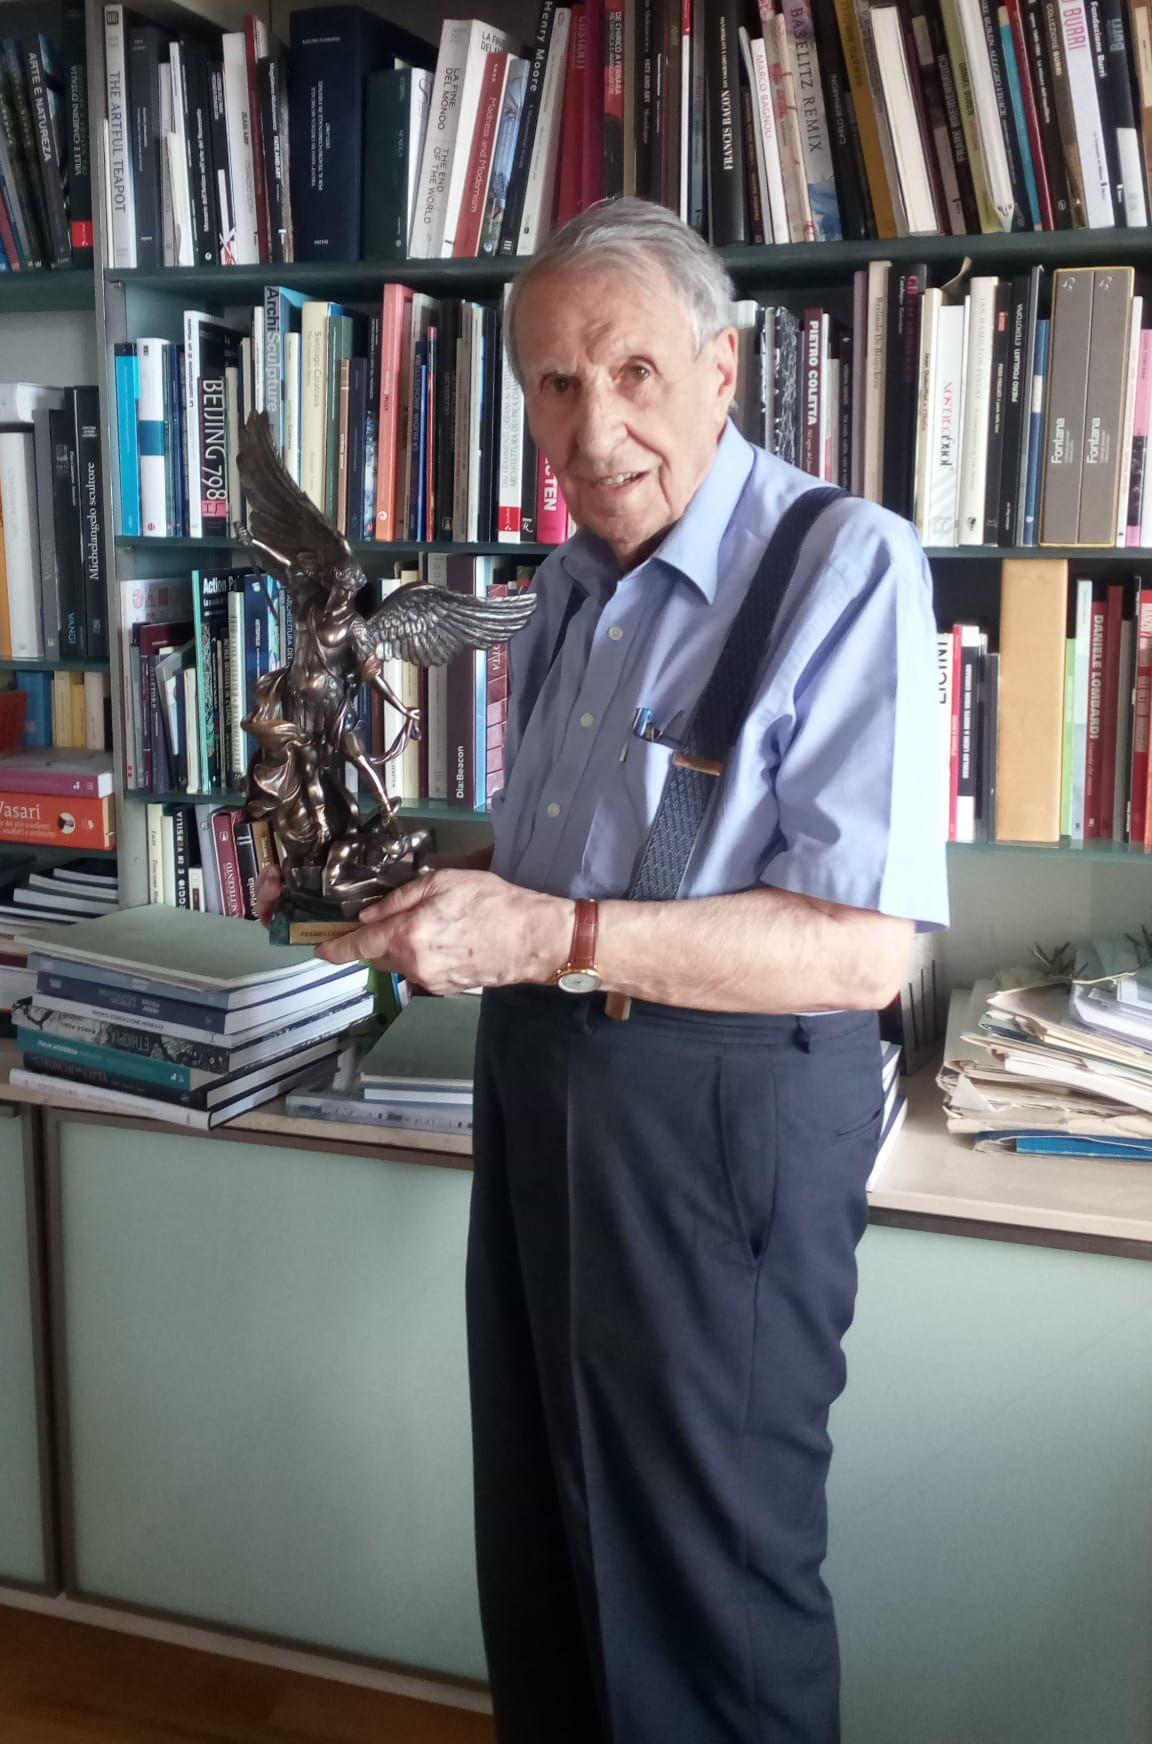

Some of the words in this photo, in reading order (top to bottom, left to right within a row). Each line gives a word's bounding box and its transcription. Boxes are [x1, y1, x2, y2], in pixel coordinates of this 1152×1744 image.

[536, 1, 553, 42] Henry
[1046, 3, 1059, 50] COLLEZIONE
[1063, 8, 1087, 51] BURRI
[1109, 18, 1125, 52] Burri
[790, 8, 815, 89] BASELITZ
[1052, 51, 1063, 76] BURRI
[1097, 55, 1107, 78] Burri
[109, 71, 121, 98] THE
[443, 67, 453, 86] DEL
[452, 67, 461, 80] LA
[490, 63, 499, 83] SASS
[529, 48, 545, 93] Moore
[754, 54, 767, 92] MARCO
[28, 52, 41, 85] ARTE
[36, 97, 51, 162] NATUREZA
[437, 90, 450, 131] MONDO
[448, 84, 458, 108] FINE
[720, 90, 732, 125] BACON
[760, 94, 772, 138] BAGNOLI
[110, 103, 124, 154] ARTFUL
[481, 97, 498, 138] Madness
[802, 96, 822, 153] REMIX
[836, 118, 846, 144] CARLO
[432, 147, 441, 161] OF
[440, 148, 450, 166] THE
[478, 139, 489, 157] and
[722, 127, 734, 170] FRANCIS
[952, 129, 967, 162] FRANK
[112, 159, 126, 214] TEAPOT
[429, 164, 439, 184] THE
[436, 171, 447, 193] END
[470, 160, 487, 213] Modernism
[423, 187, 436, 225] WORLD
[874, 297, 884, 332] Berlinde
[1013, 304, 1024, 346] ETEROTOPIA
[266, 287, 281, 412] ArchiSculpture
[808, 320, 819, 367] PIETRO
[1012, 348, 1021, 380] FOGLIATI
[807, 370, 818, 425] COLETTA
[1011, 381, 1019, 402] PIERO
[202, 379, 227, 460] BEIJING
[1051, 417, 1066, 464] Fontana
[1086, 417, 1102, 464] Fontana
[85, 462, 95, 505] scultore
[202, 465, 226, 501] 798
[87, 507, 99, 580] Michelangelo
[203, 577, 227, 595] Action
[66, 612, 76, 644] VANGI
[1091, 614, 1104, 668] DANIELE
[1089, 671, 1102, 739] LOMBARDI
[456, 745, 465, 799] Dia:Beacon
[176, 811, 184, 852] VERSILIA
[176, 855, 184, 864] IN
[225, 862, 239, 913] SETTECENTO
[246, 877, 258, 906] Pistoia
[110, 1029, 151, 1052] ETHIOPIA
